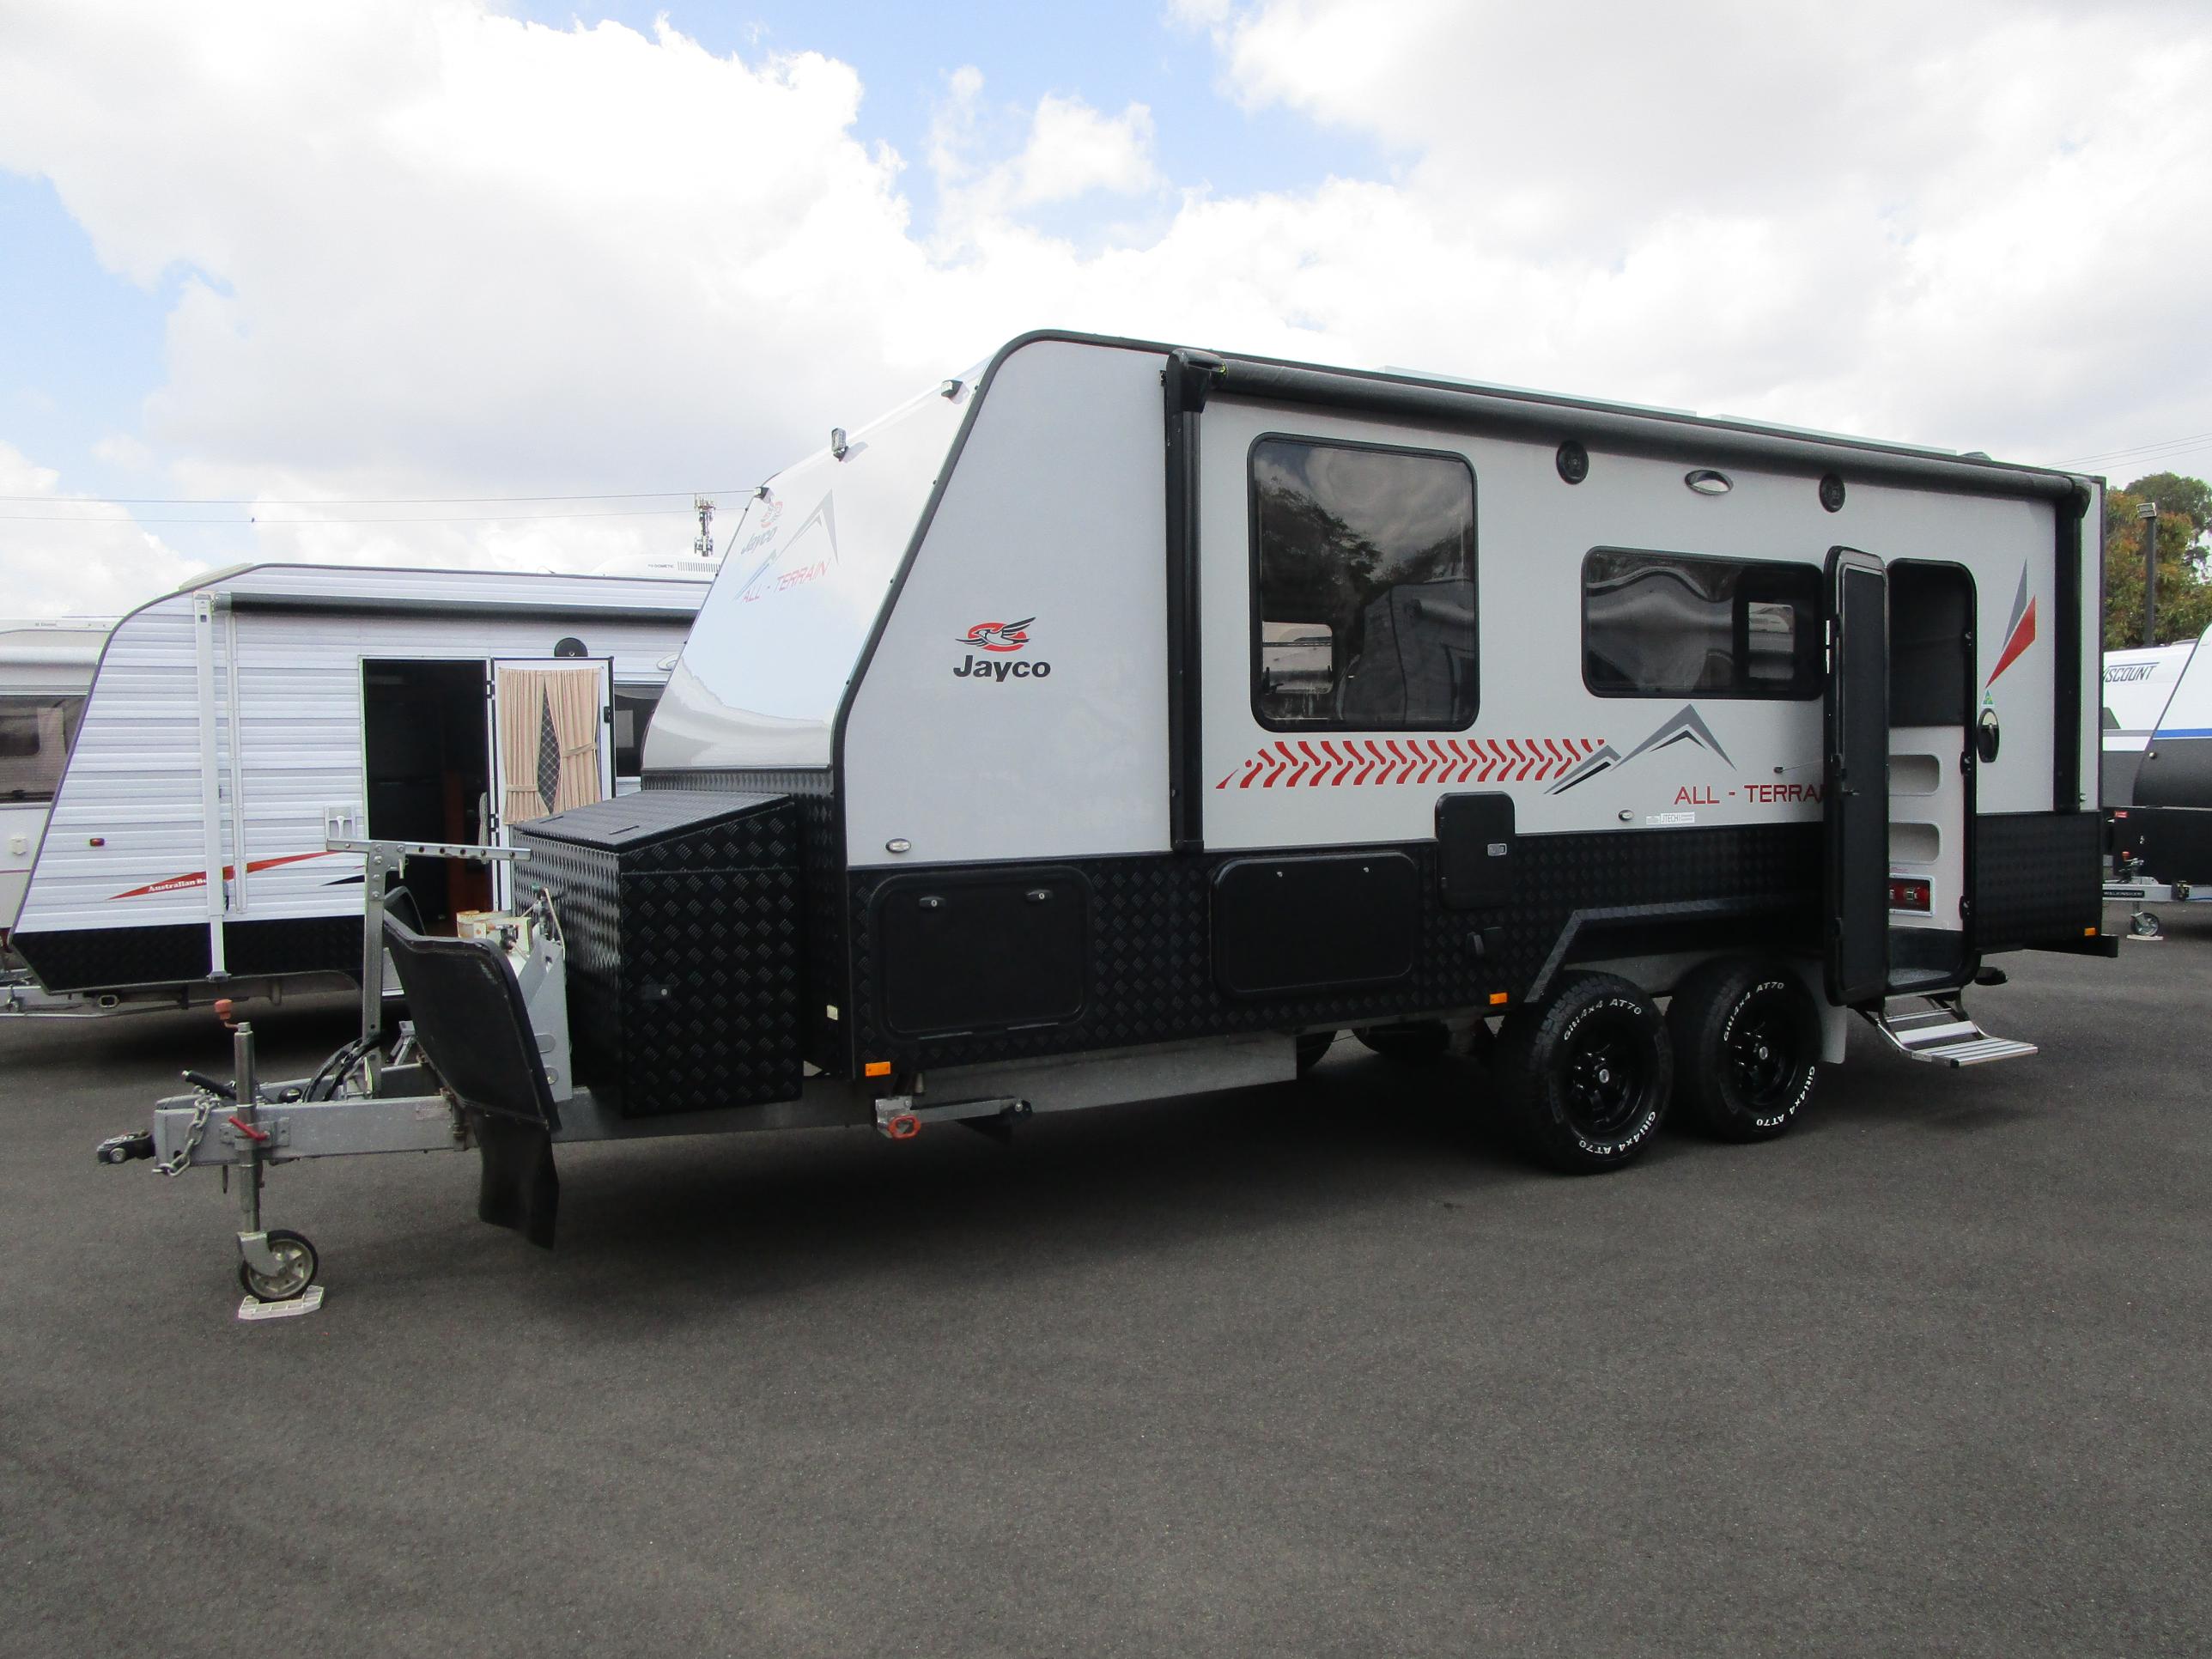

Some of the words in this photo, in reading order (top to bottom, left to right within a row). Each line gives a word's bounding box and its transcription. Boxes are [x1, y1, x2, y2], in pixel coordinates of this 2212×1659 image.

[742, 584, 763, 603] ALL
[775, 557, 832, 592] TERRAIN
[953, 655, 1051, 682] Jayco
[1674, 786, 1720, 805] ALL
[148, 880, 196, 892] Australian
[1756, 981, 1784, 993] AT70
[1609, 999, 1642, 1015] AT70
[1756, 1114, 1784, 1127] AT70
[1578, 1139, 1611, 1154] AT70
